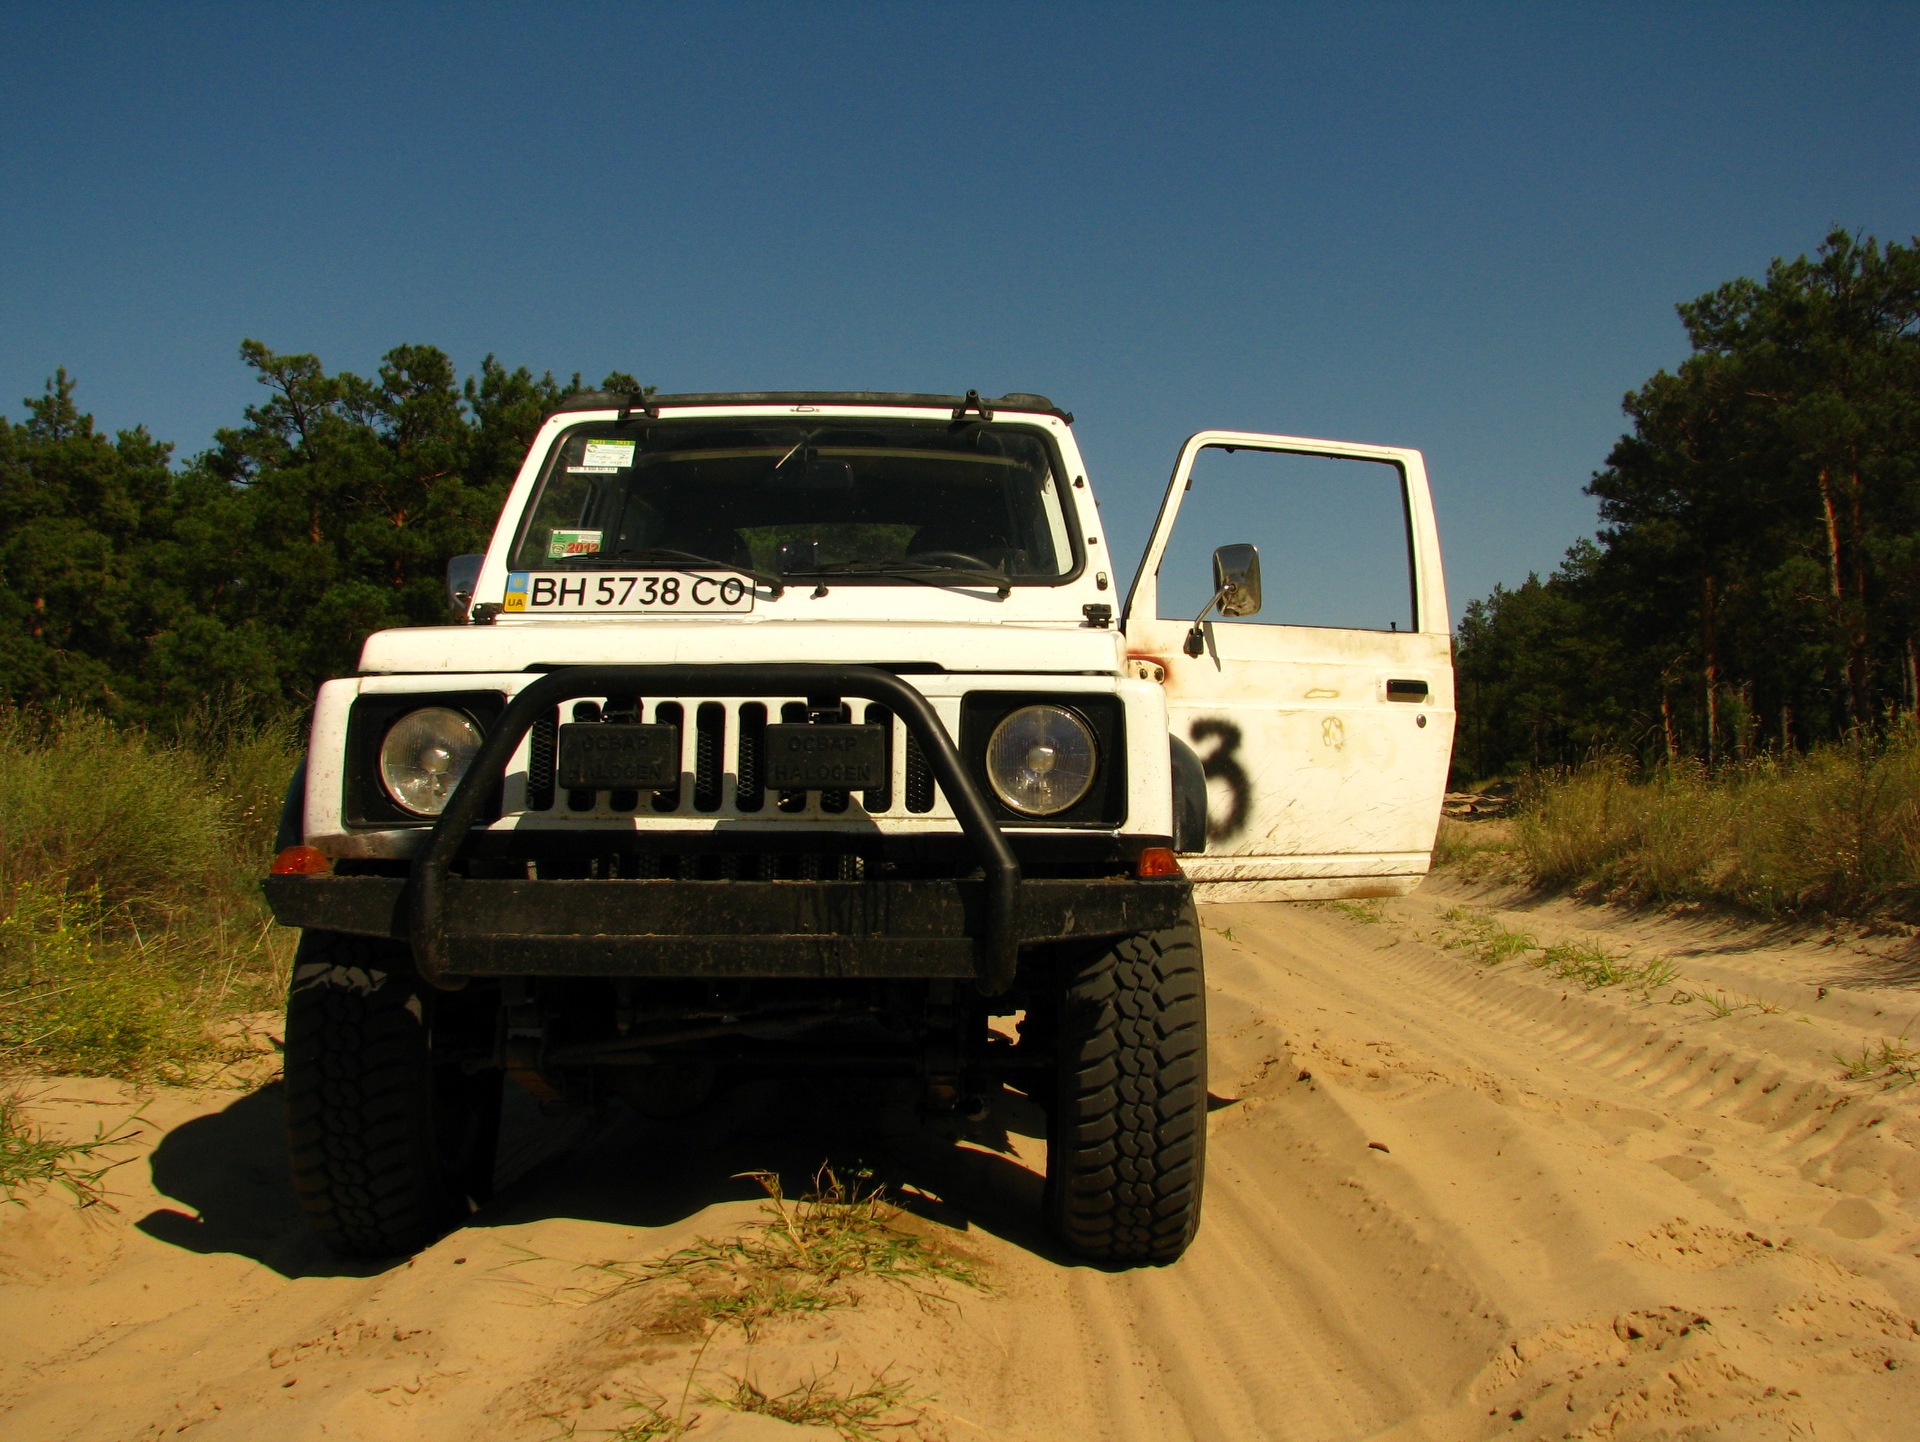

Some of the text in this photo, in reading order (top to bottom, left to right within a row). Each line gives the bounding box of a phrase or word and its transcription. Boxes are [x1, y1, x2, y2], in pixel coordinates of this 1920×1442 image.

[566, 542, 599, 554] 2012
[531, 576, 746, 607] BH 5738 CO
[507, 597, 524, 608] UA
[775, 763, 871, 782] HALOGEN
